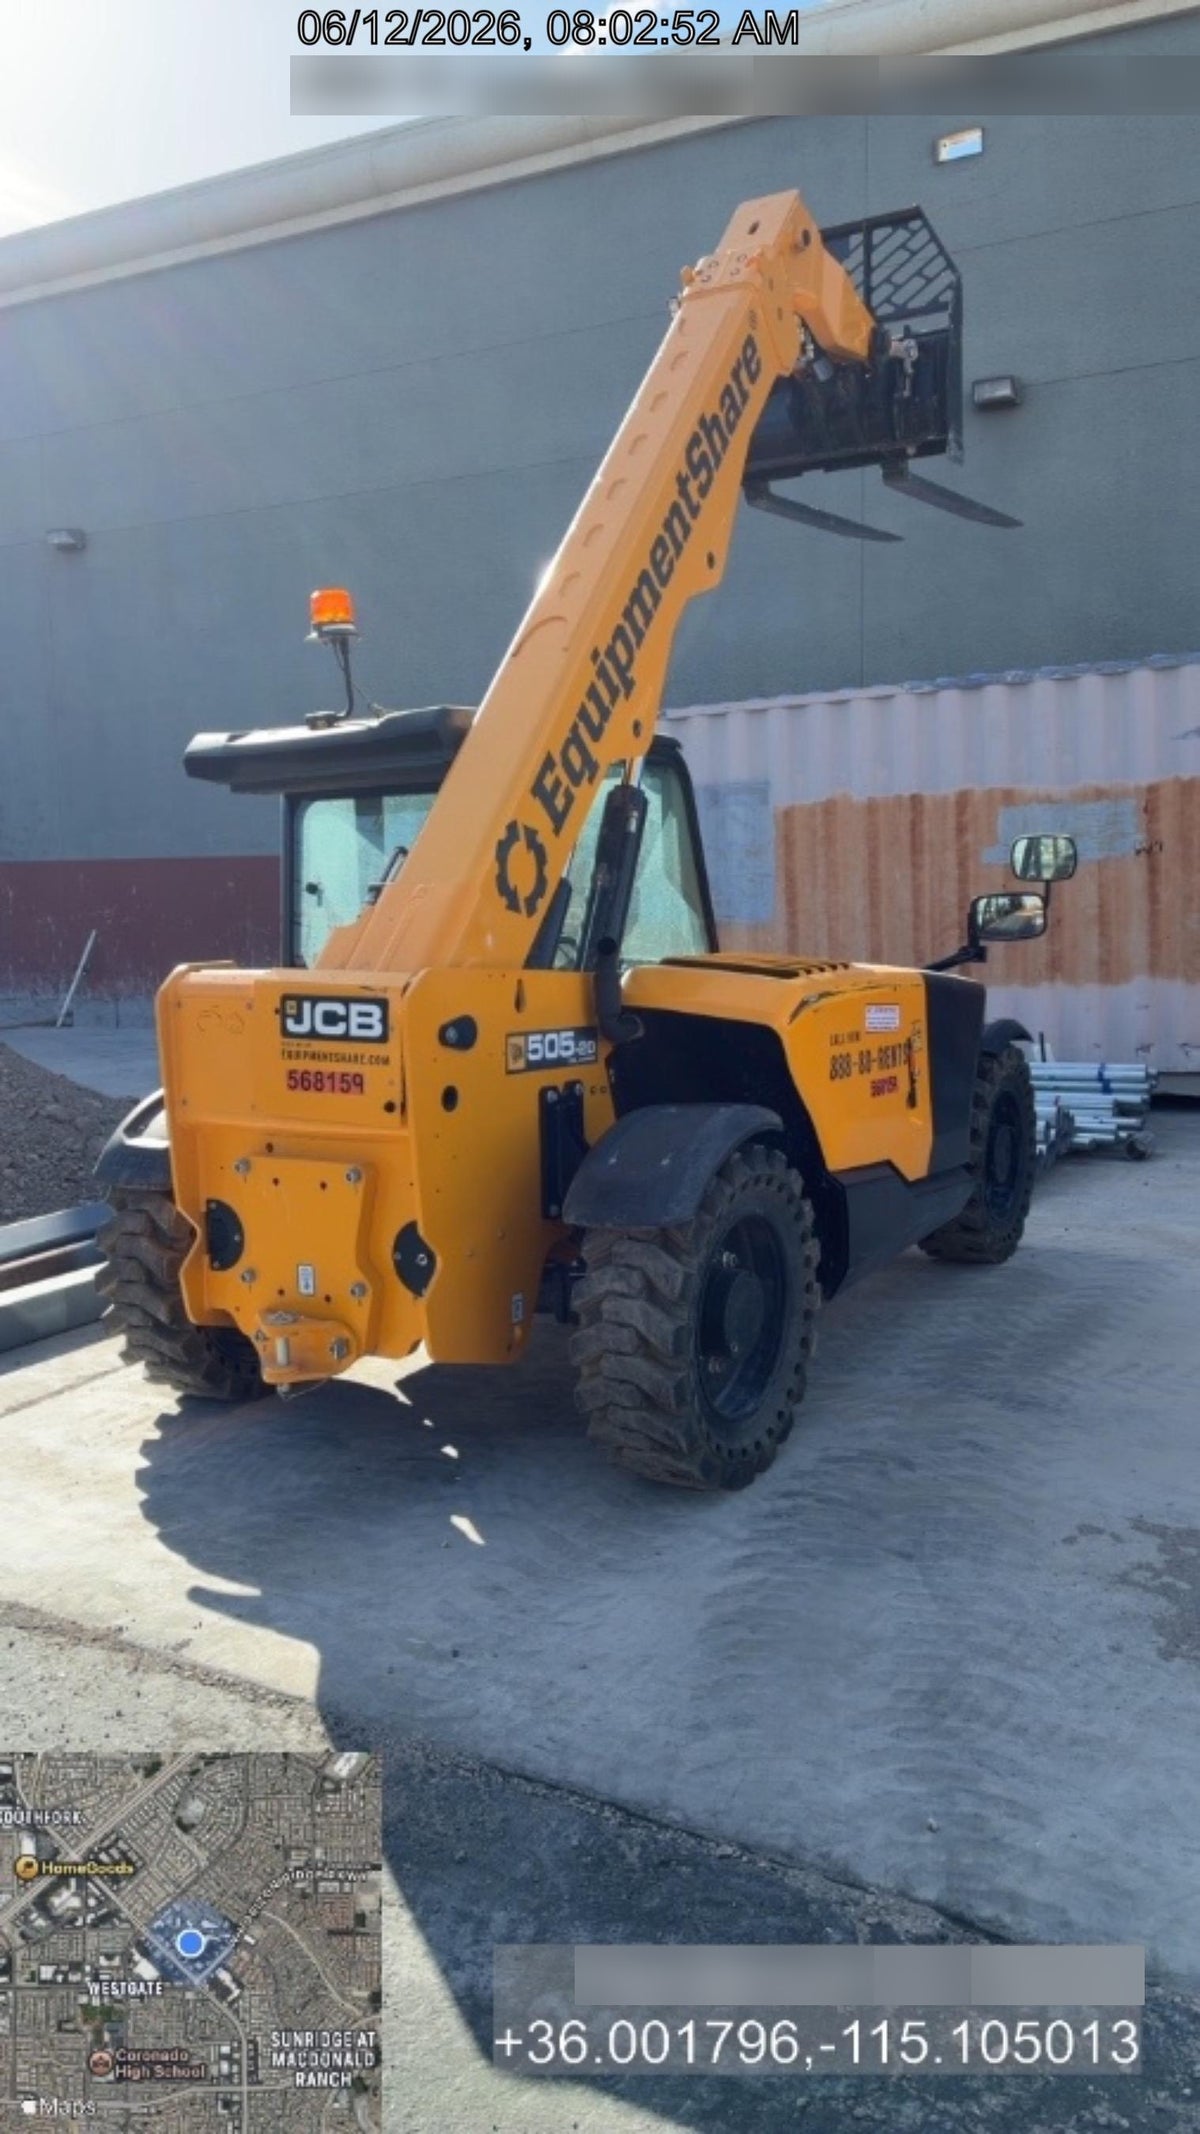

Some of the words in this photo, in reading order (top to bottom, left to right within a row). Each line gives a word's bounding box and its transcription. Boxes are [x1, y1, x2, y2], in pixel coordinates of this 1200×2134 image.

[529, 331, 763, 839] EquipmentShare
[286, 1000, 384, 1038] JCB
[287, 1069, 364, 1095] 568159
